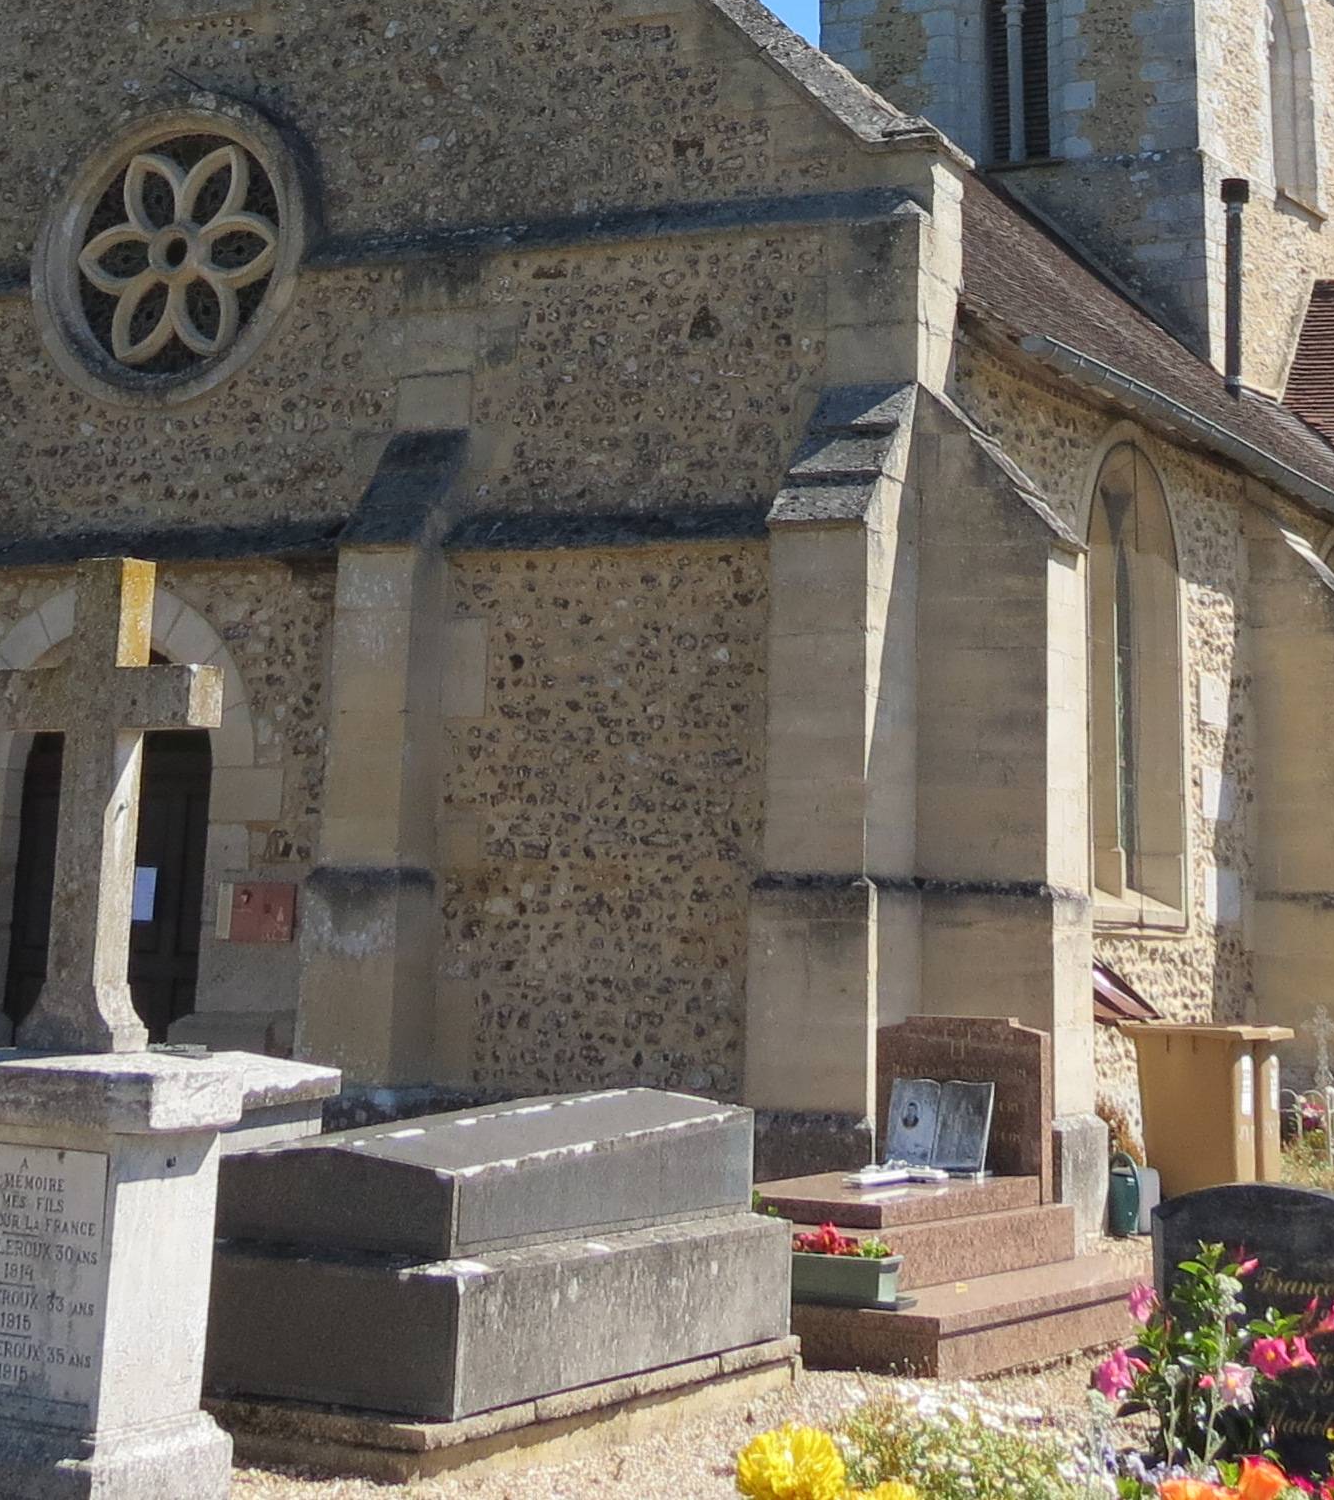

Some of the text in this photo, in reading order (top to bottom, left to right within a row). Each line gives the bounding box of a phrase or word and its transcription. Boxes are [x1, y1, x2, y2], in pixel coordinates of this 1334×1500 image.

[2, 1192, 27, 1210] MES
[36, 1196, 65, 1214] FILS
[44, 1218, 97, 1237] FRANCE
[54, 1243, 74, 1262] 30
[46, 1346, 65, 1365] 35
